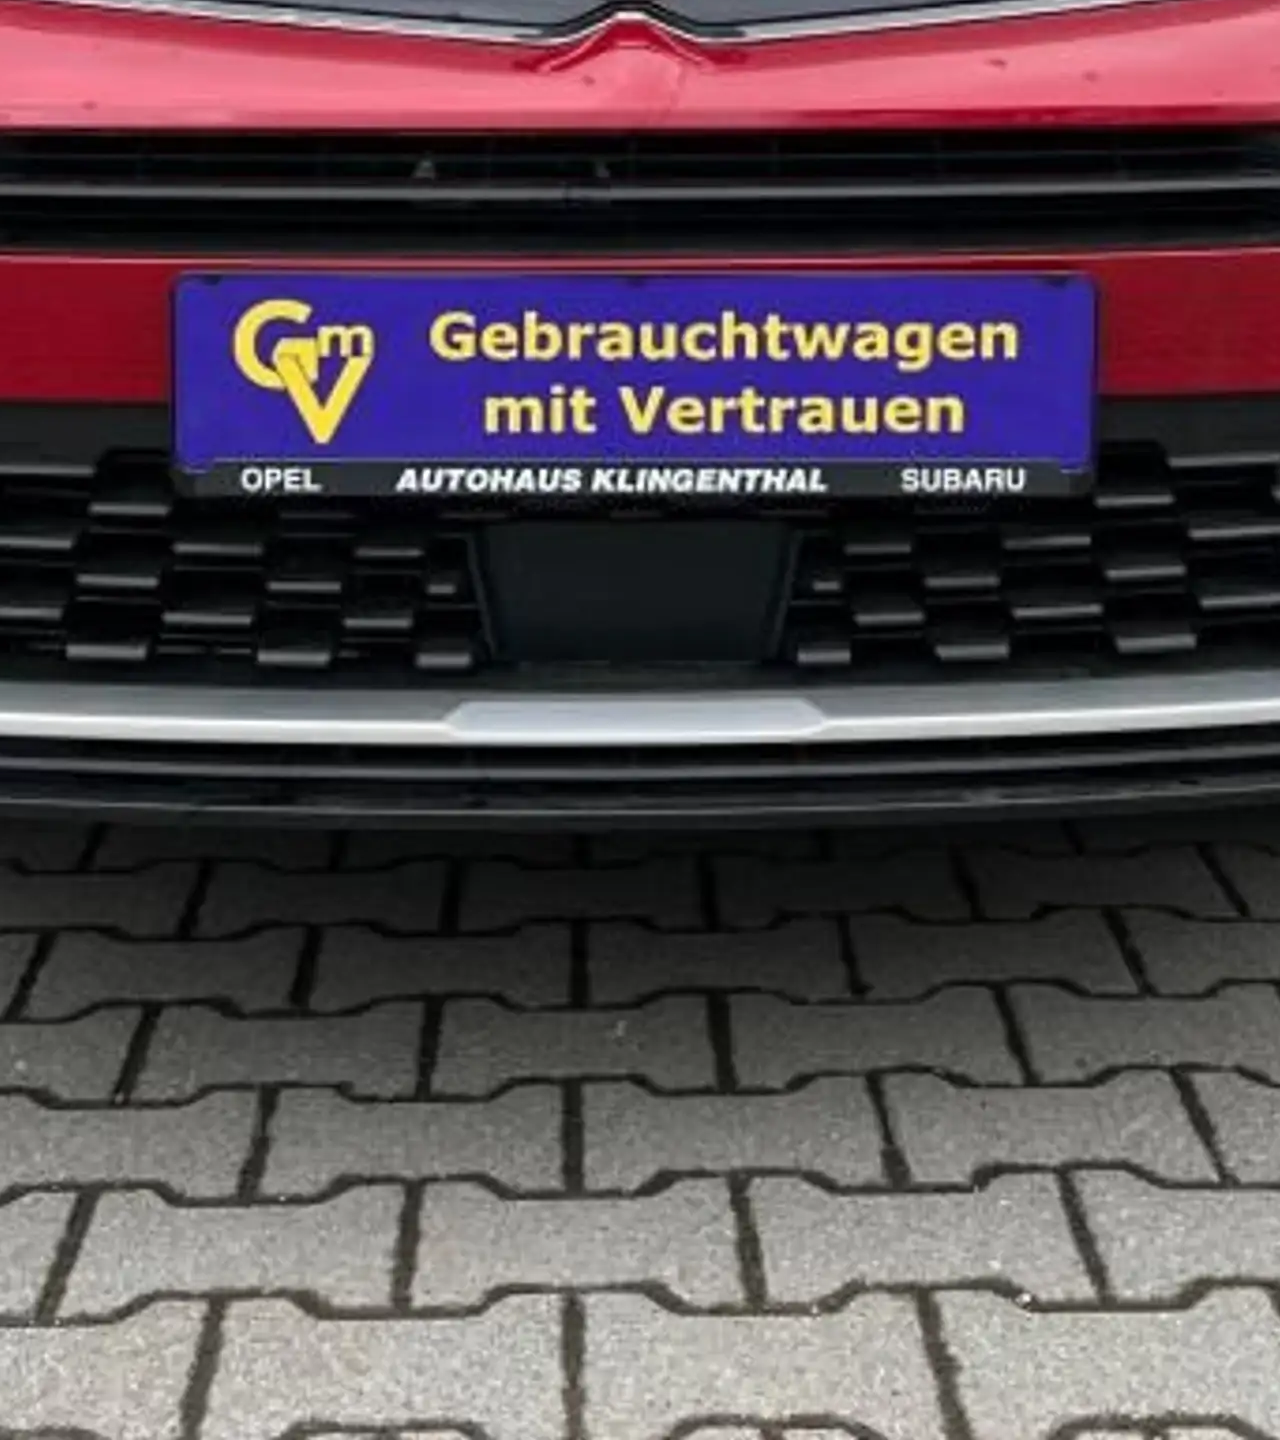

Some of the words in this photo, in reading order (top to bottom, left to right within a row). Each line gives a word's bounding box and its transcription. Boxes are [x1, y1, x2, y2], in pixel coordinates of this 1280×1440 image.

[429, 310, 1018, 371] Gebrauchtwagen
[484, 383, 596, 434] mit
[618, 385, 965, 434] Vertrauen
[240, 467, 322, 493] OPEL
[394, 467, 582, 494] AUTOHAUS
[590, 467, 828, 494] KLINGENTHAL
[900, 467, 1027, 494] SUBARU
